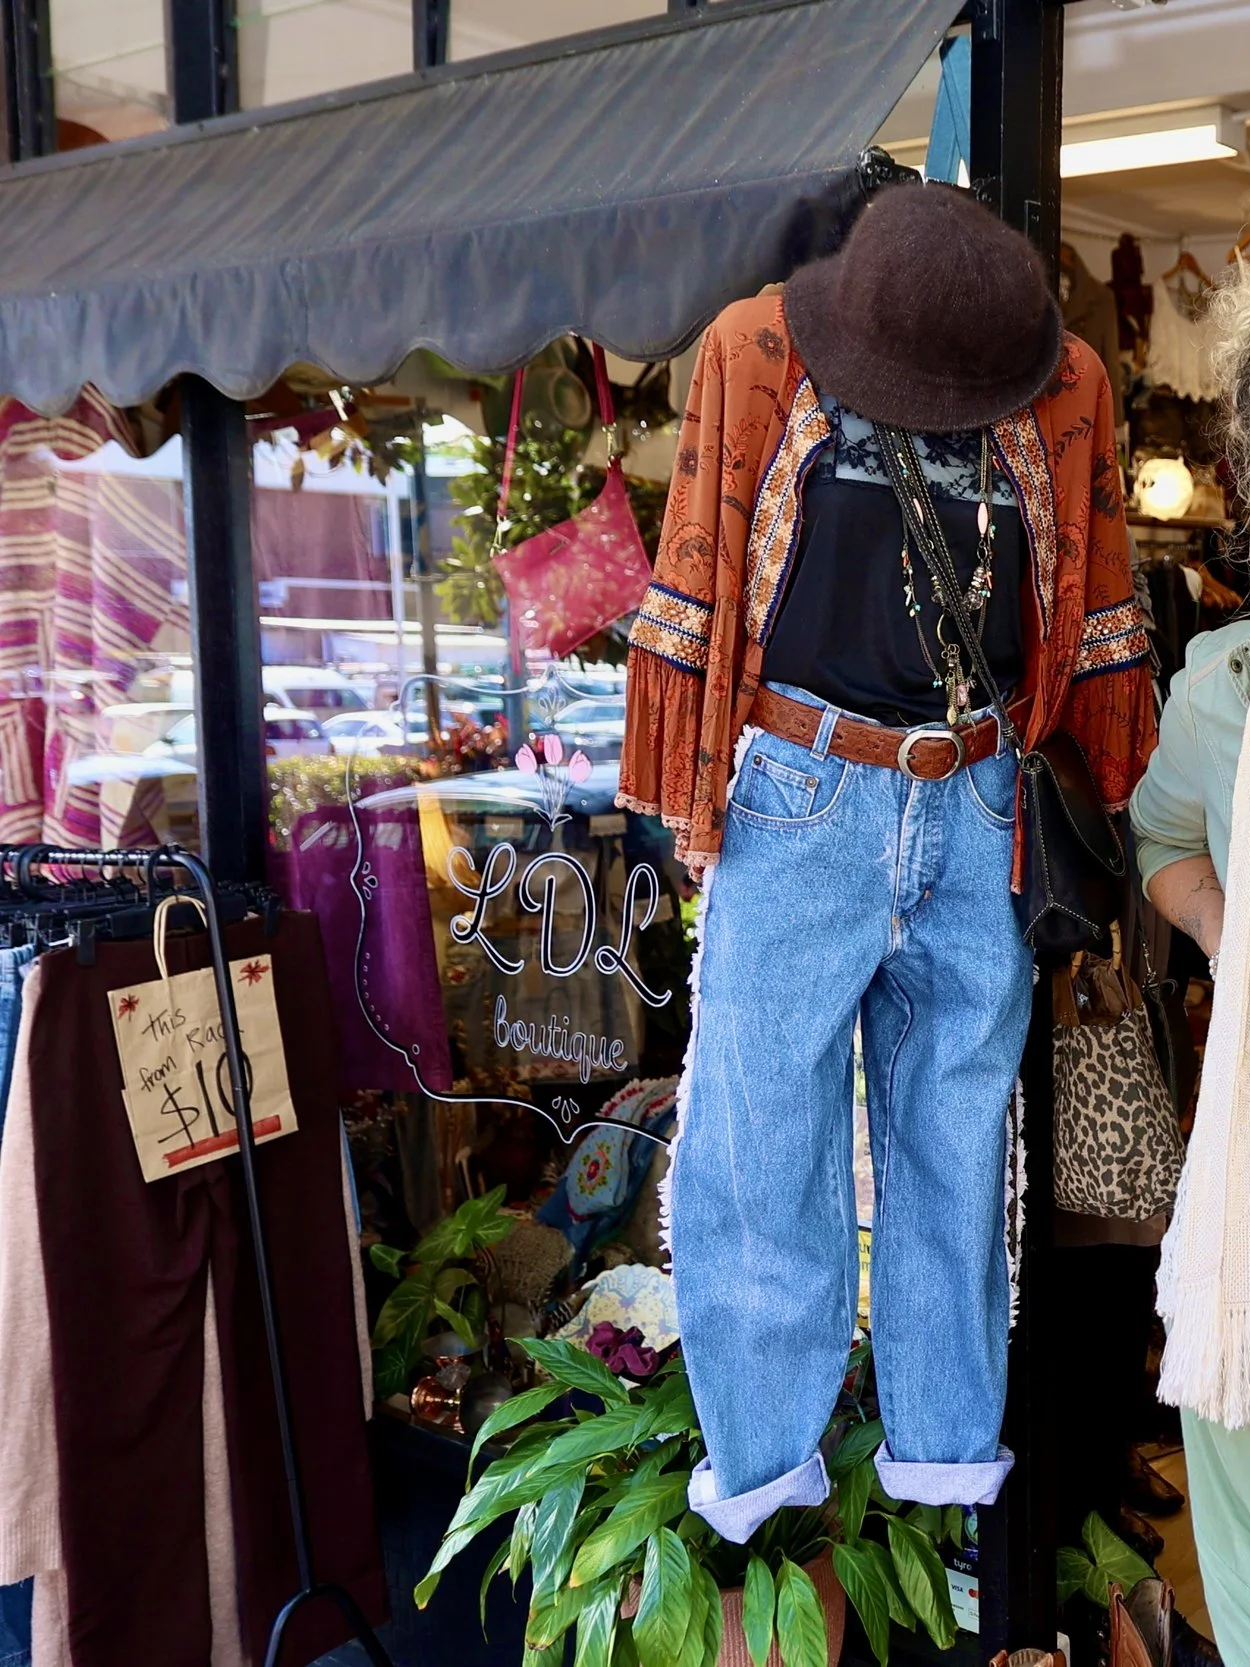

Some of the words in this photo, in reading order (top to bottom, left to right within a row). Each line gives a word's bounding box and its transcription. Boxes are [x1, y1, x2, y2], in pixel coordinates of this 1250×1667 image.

[448, 842, 672, 1007] LDL
[186, 1022, 244, 1052] Rac
[494, 995, 628, 1084] boutique
[139, 1055, 177, 1093] from
[158, 1049, 253, 1148] $10
[953, 1558, 972, 1571] tyro
[951, 1584, 964, 1593] VISA
